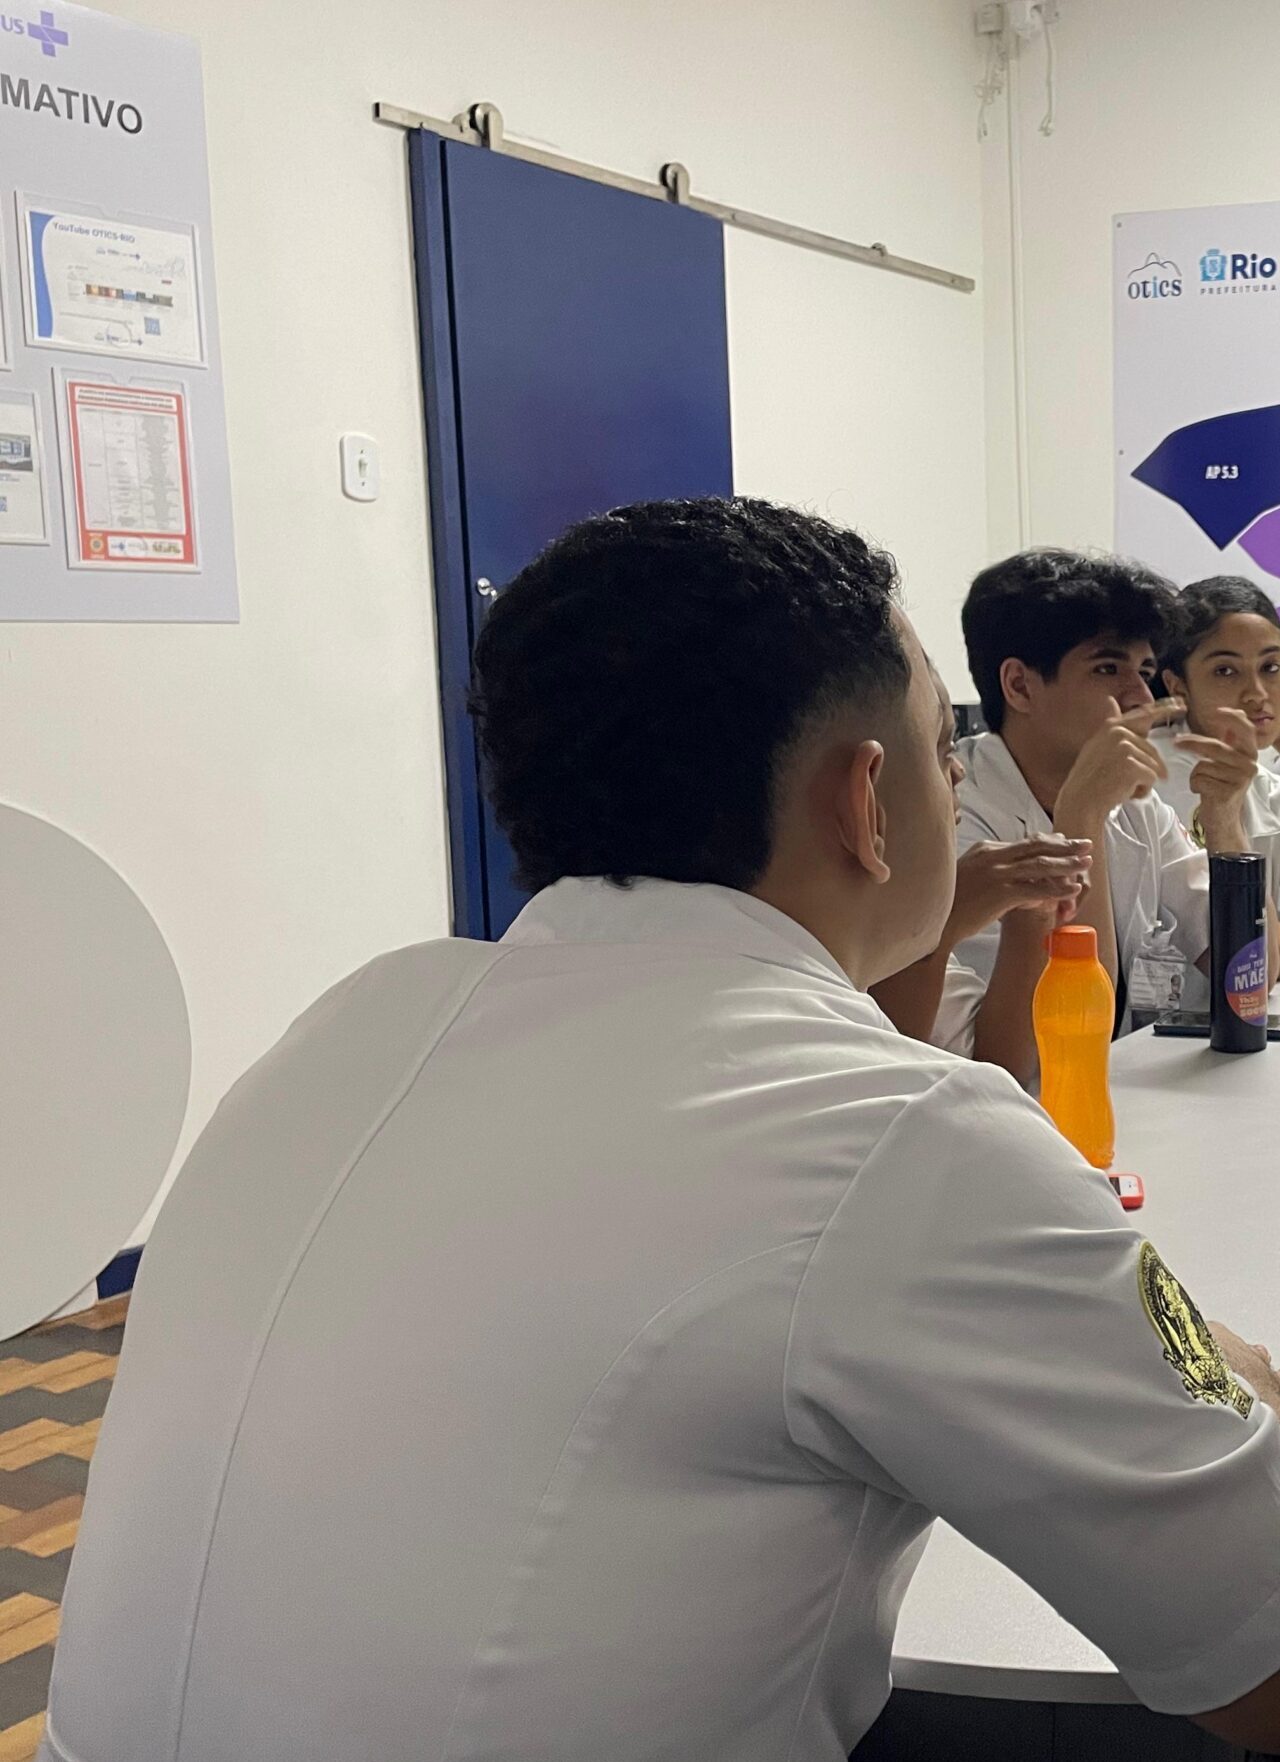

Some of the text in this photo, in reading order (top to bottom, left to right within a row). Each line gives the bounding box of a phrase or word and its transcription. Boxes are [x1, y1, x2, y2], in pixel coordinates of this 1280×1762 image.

[0, 73, 143, 134] MATIVO
[53, 222, 90, 235] YouTube
[1231, 253, 1277, 280] Rio
[1127, 276, 1183, 299] otics
[1200, 284, 1276, 296] PREFEITURA
[1205, 465, 1239, 479] AP 5.3
